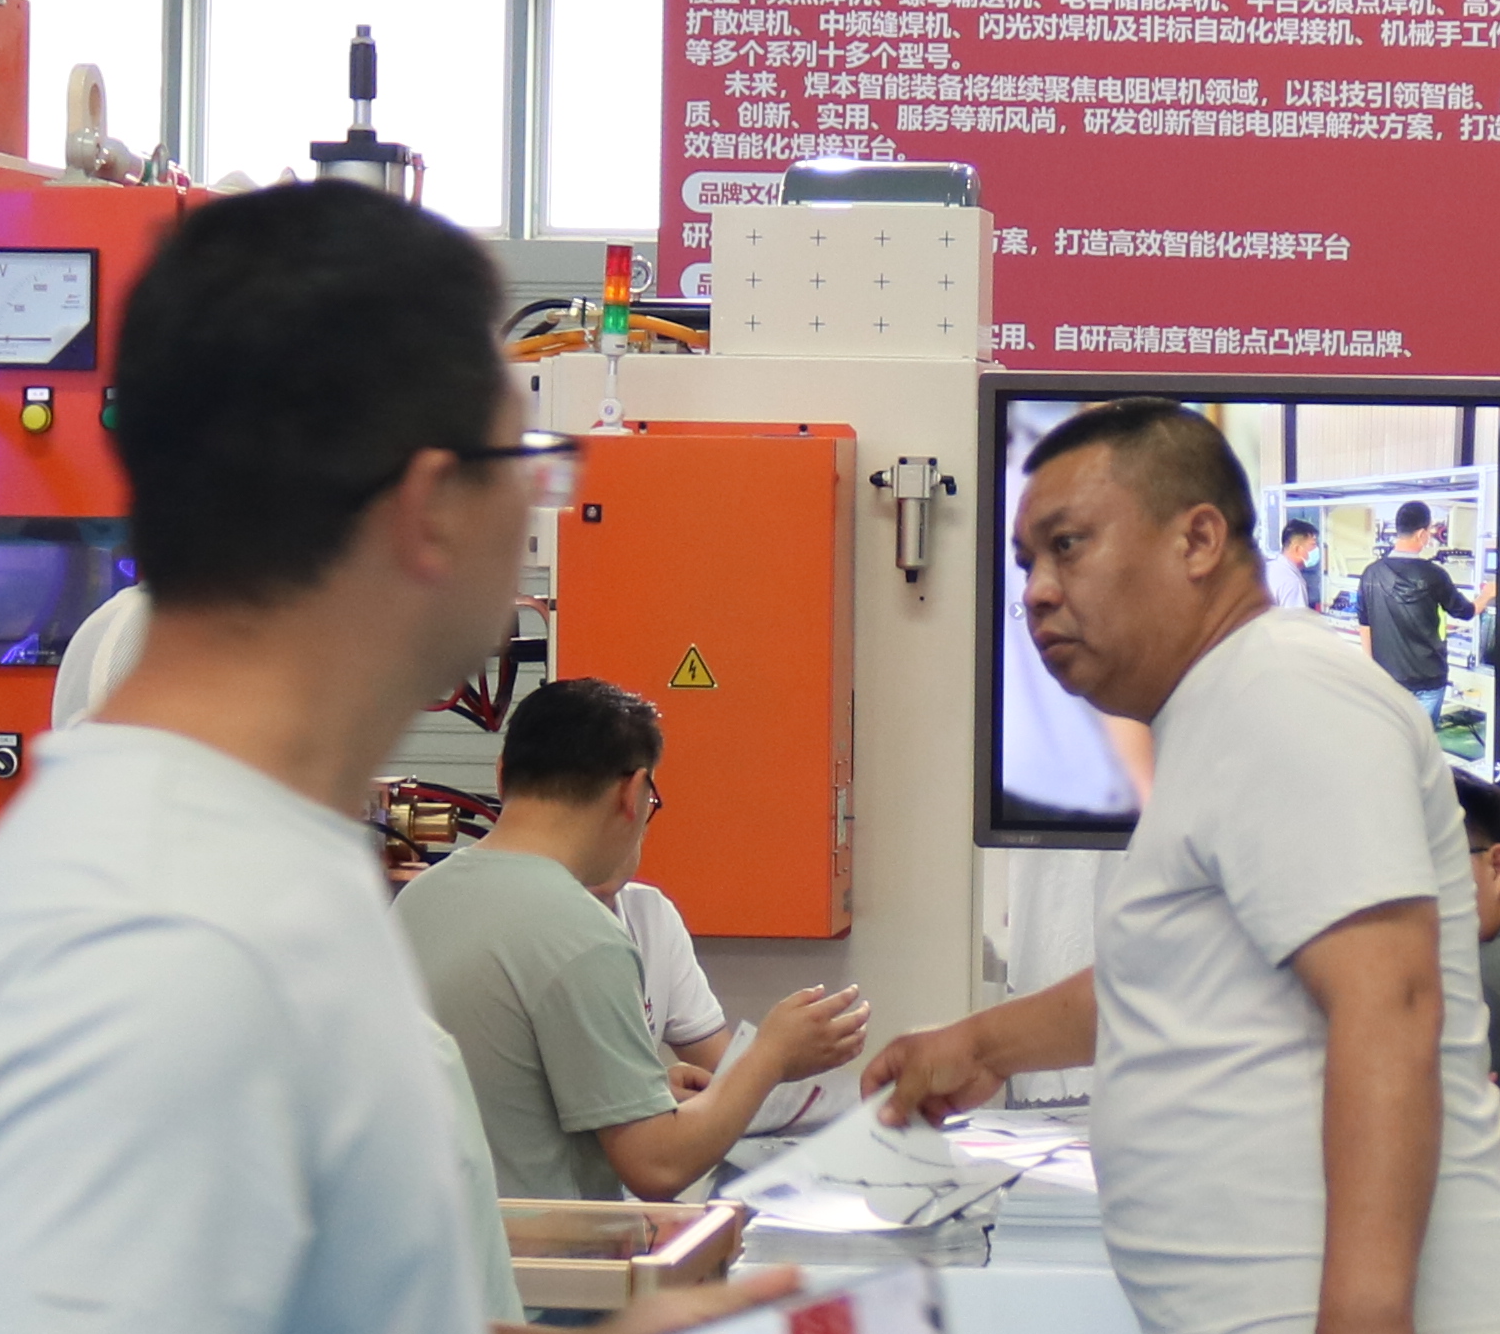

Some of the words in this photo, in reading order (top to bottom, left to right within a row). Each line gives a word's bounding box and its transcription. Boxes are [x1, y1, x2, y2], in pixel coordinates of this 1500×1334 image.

[682, 222, 712, 249] 研
[992, 228, 1350, 261] 案，打造高效智能化焊接平台
